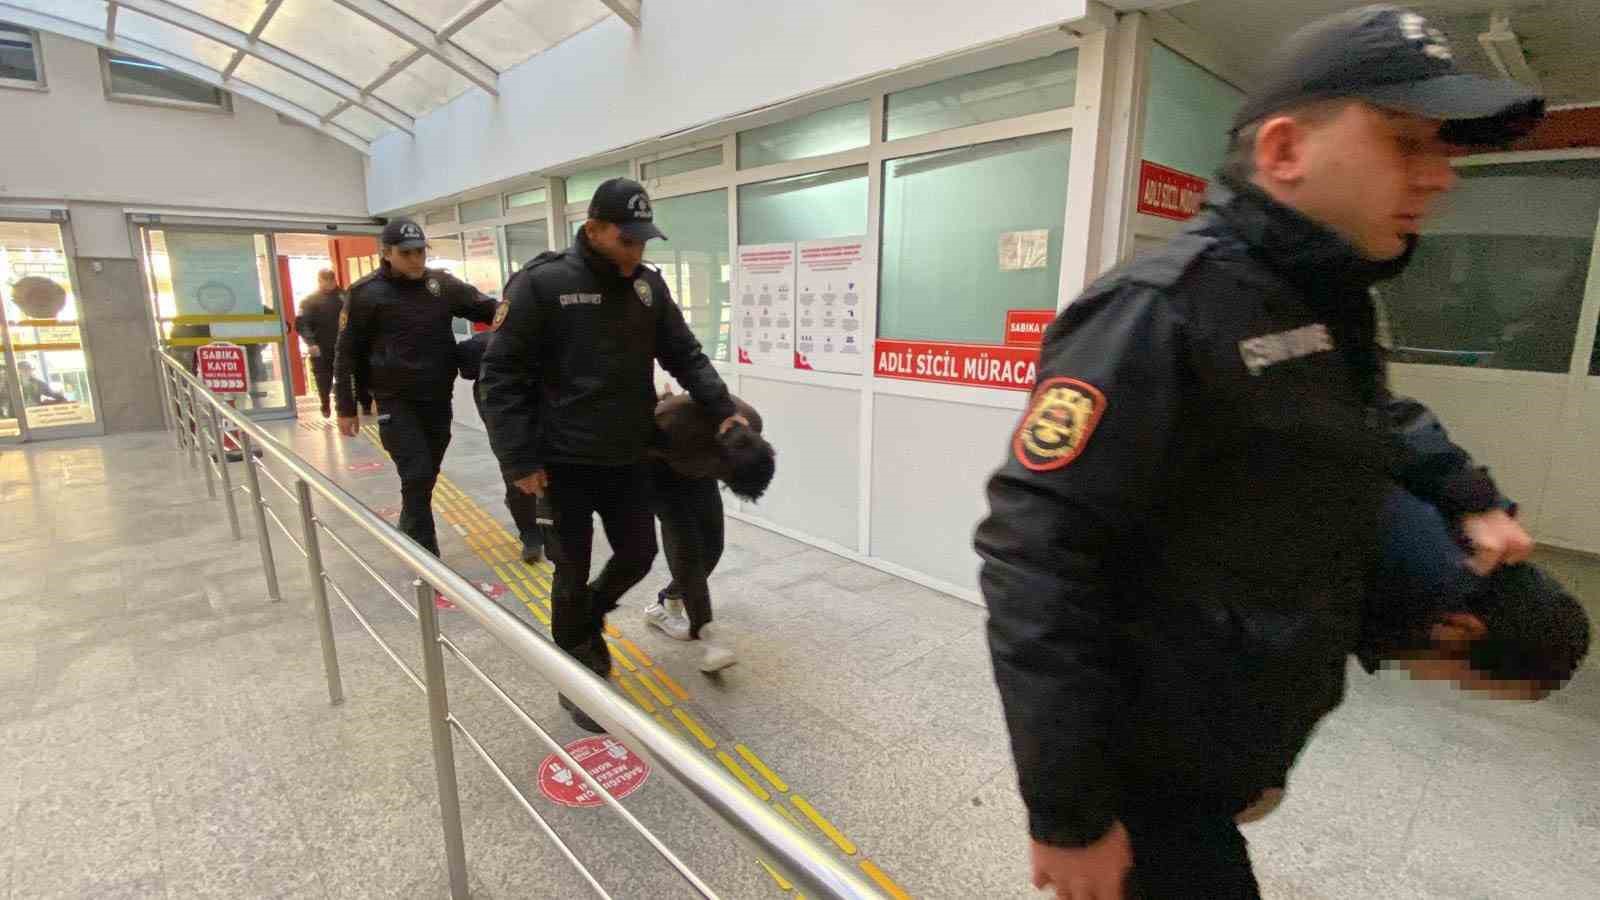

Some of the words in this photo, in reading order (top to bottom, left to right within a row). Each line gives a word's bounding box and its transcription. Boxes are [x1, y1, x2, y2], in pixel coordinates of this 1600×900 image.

[1010, 322, 1041, 334] SABIKA
[202, 350, 240, 360] SABIKA
[207, 361, 238, 371] KAYDI
[878, 348, 913, 373] ADLİ
[916, 349, 959, 378] SİCİL
[963, 353, 1037, 384] MÜRACA
